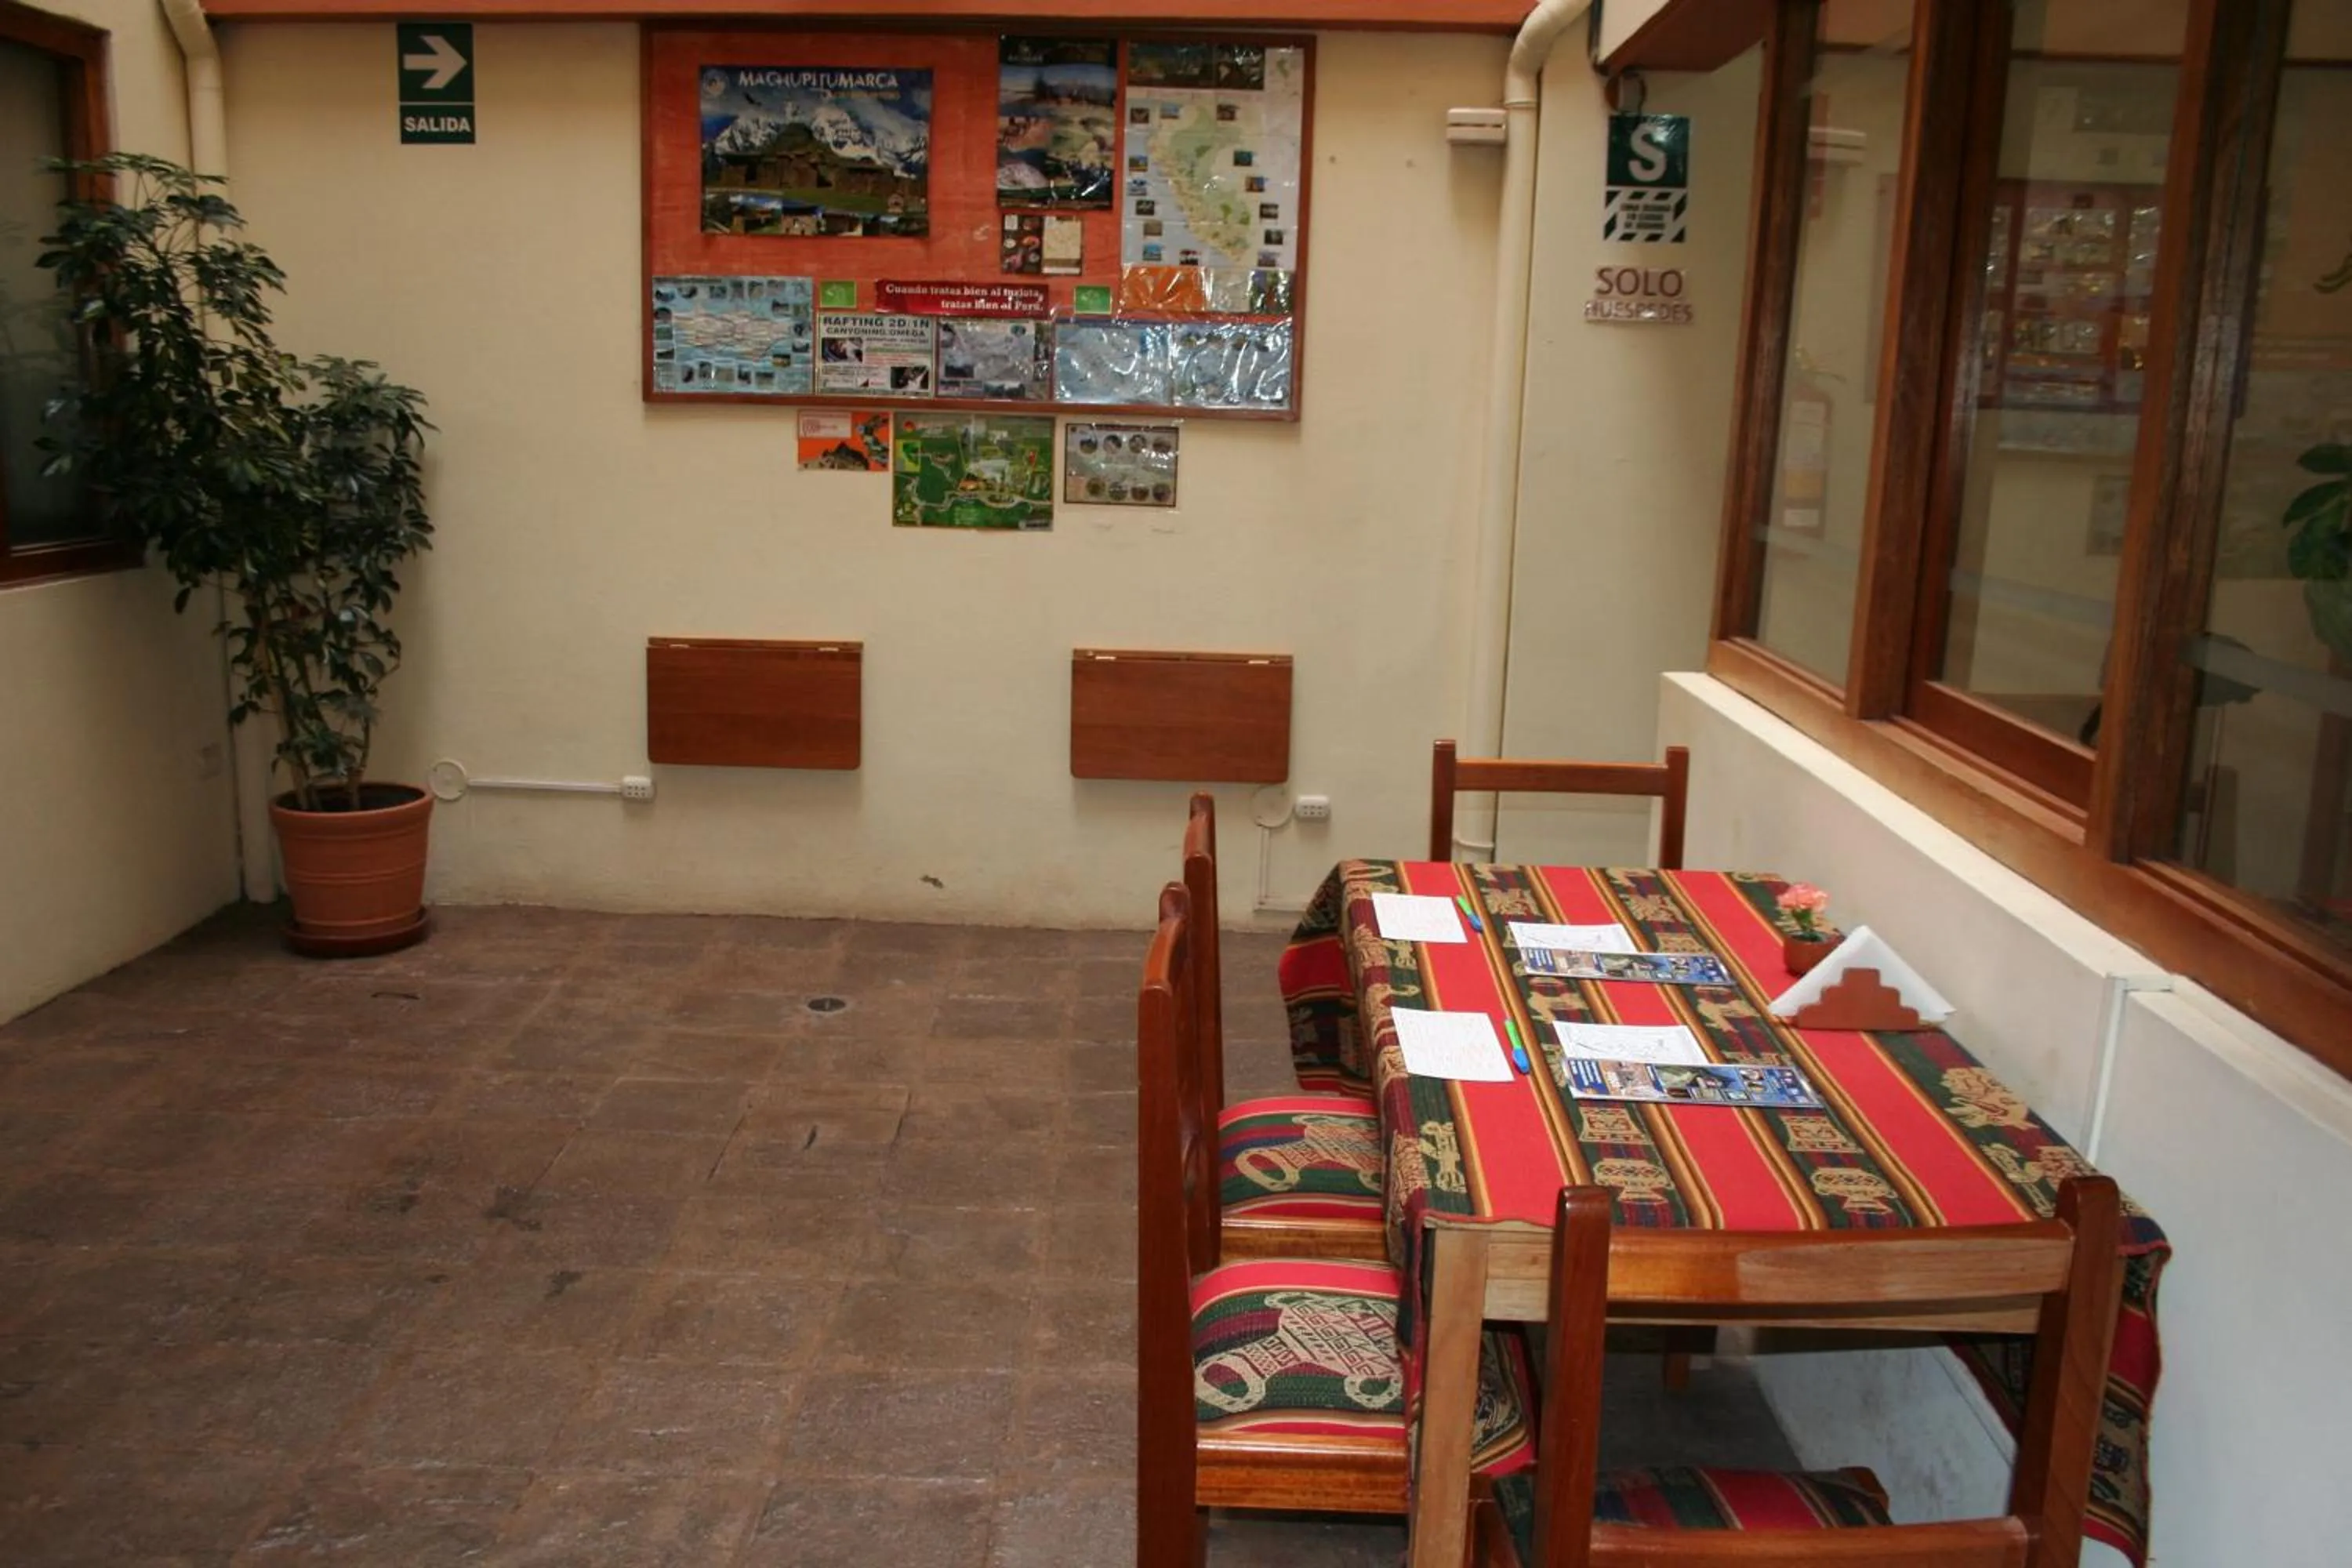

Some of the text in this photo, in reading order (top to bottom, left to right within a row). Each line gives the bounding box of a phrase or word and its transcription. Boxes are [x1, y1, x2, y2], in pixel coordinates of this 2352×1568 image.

[404, 116, 471, 132] SALIDA
[1628, 122, 1668, 182] S
[1595, 267, 1683, 298] SOLO
[930, 285, 961, 296] tratas
[964, 286, 988, 296] bien
[990, 288, 1001, 296] al
[941, 299, 971, 309] tratas
[823, 317, 884, 327] RAFTING
